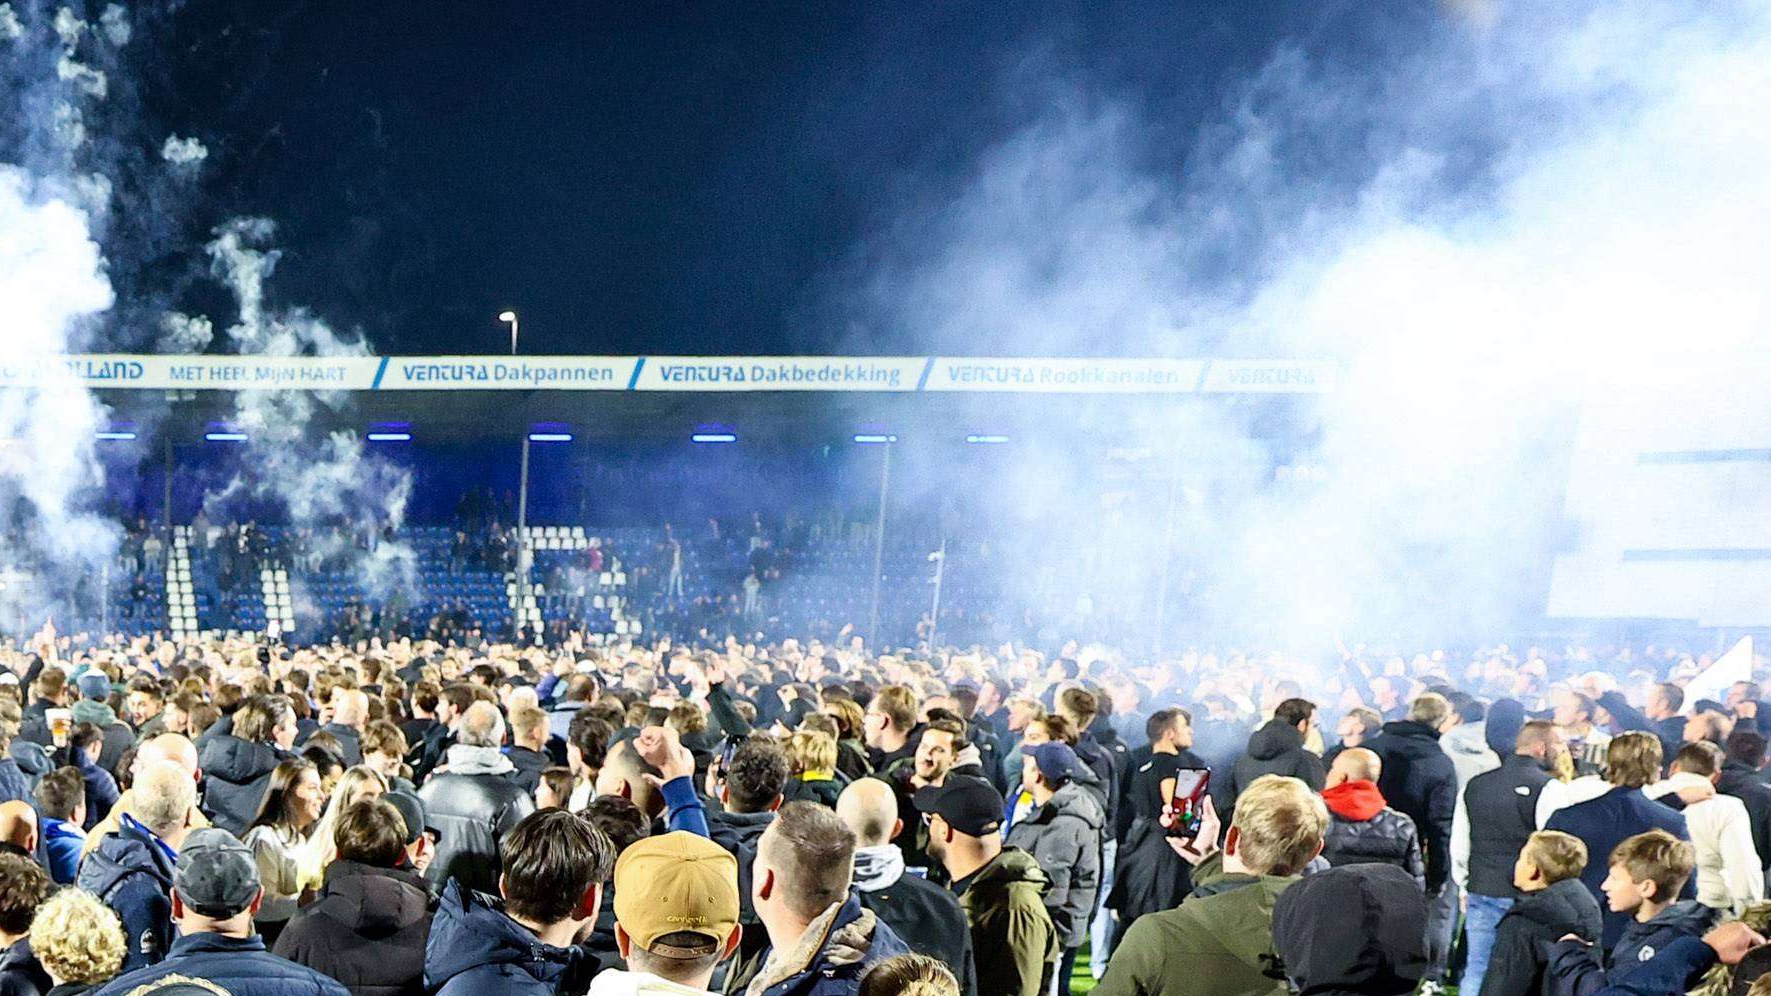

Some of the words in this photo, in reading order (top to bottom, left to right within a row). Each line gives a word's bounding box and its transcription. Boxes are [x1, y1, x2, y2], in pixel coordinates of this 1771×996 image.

[169, 366, 205, 381] MET
[208, 366, 251, 381] HEEL
[299, 366, 347, 381] HART
[403, 364, 489, 381] VENTURA
[493, 363, 614, 385] Dakpannen
[660, 365, 746, 382] VENTURA
[751, 364, 901, 387] Dakbedekking
